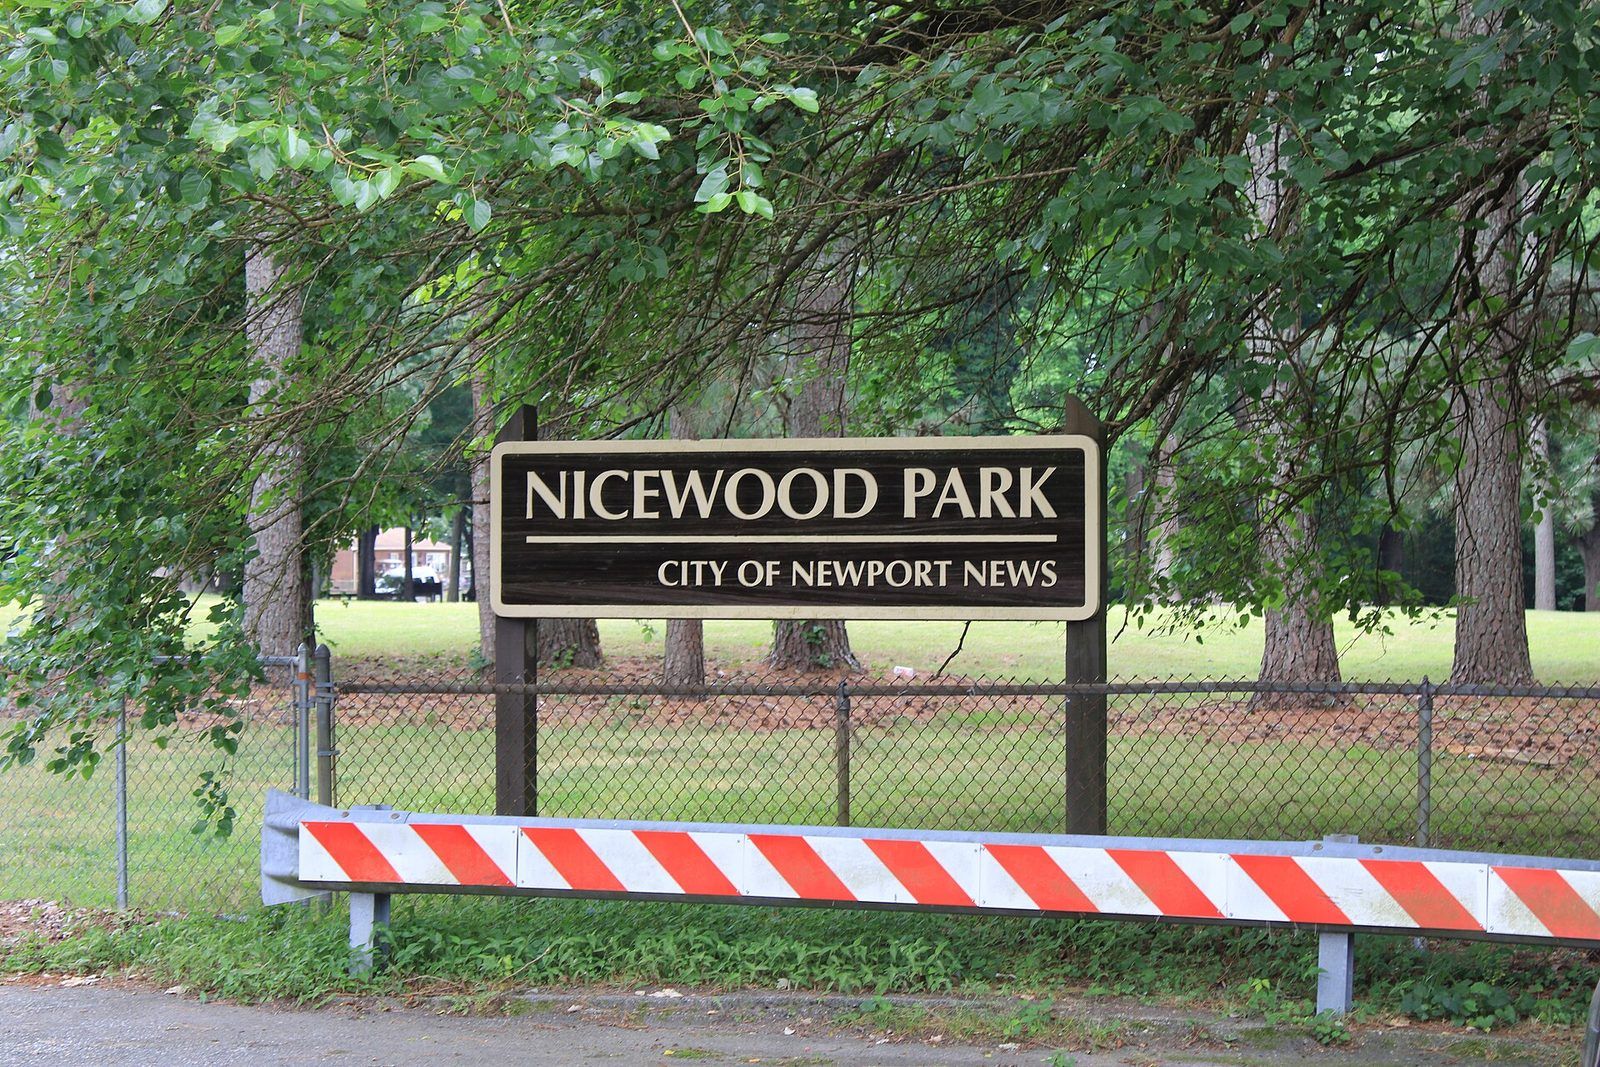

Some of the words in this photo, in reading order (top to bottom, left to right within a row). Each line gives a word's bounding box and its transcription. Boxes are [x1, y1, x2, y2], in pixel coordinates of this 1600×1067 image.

[525, 467, 879, 520] NICEWOOD
[903, 466, 1058, 519] PARK
[657, 560, 729, 587] CITY
[737, 560, 781, 587] OF
[791, 560, 953, 587] NEWPORT
[963, 560, 1058, 587] NEWS
